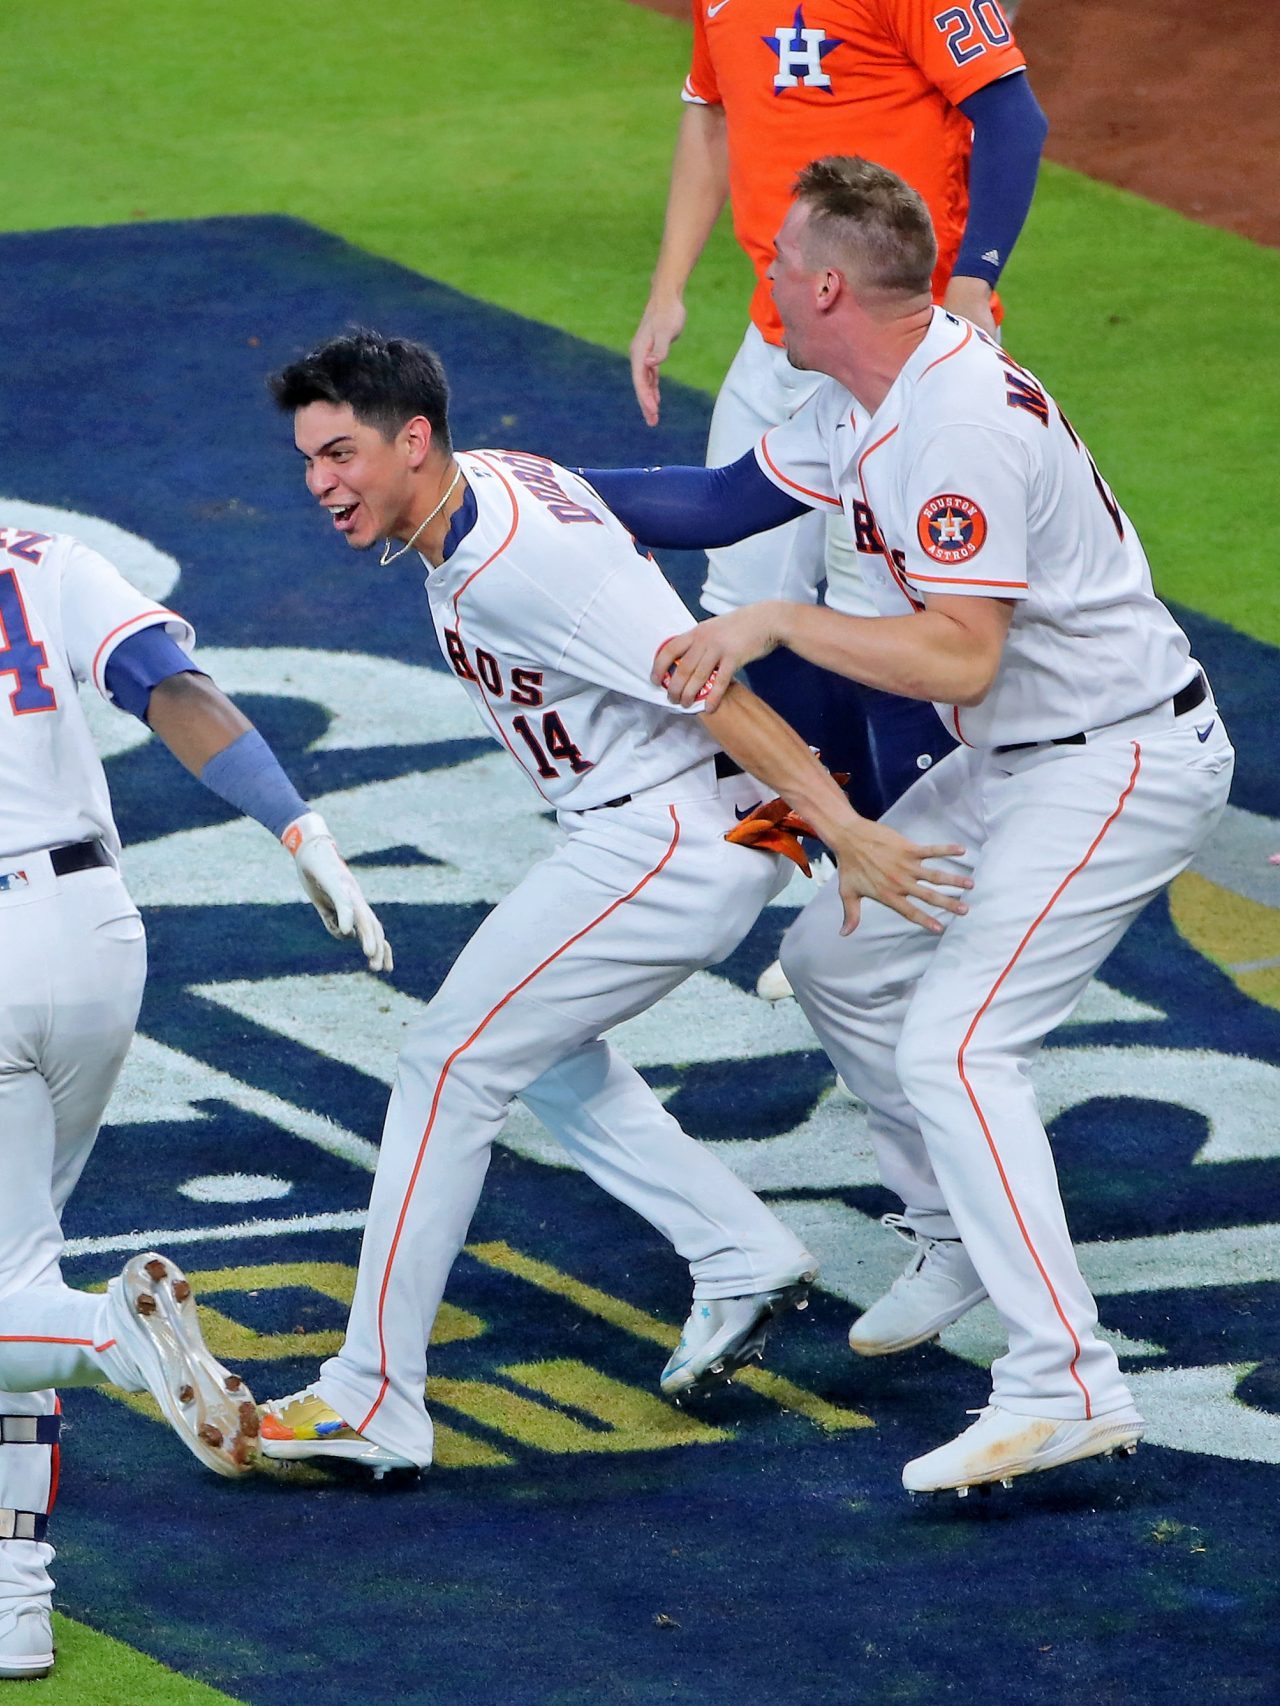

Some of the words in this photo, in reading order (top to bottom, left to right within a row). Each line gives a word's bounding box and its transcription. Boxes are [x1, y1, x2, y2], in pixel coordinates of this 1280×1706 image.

[933, 0, 1011, 67] 20
[923, 497, 978, 518] HOUSTON
[928, 543, 976, 560] ASTROS
[512, 711, 594, 779] 14
